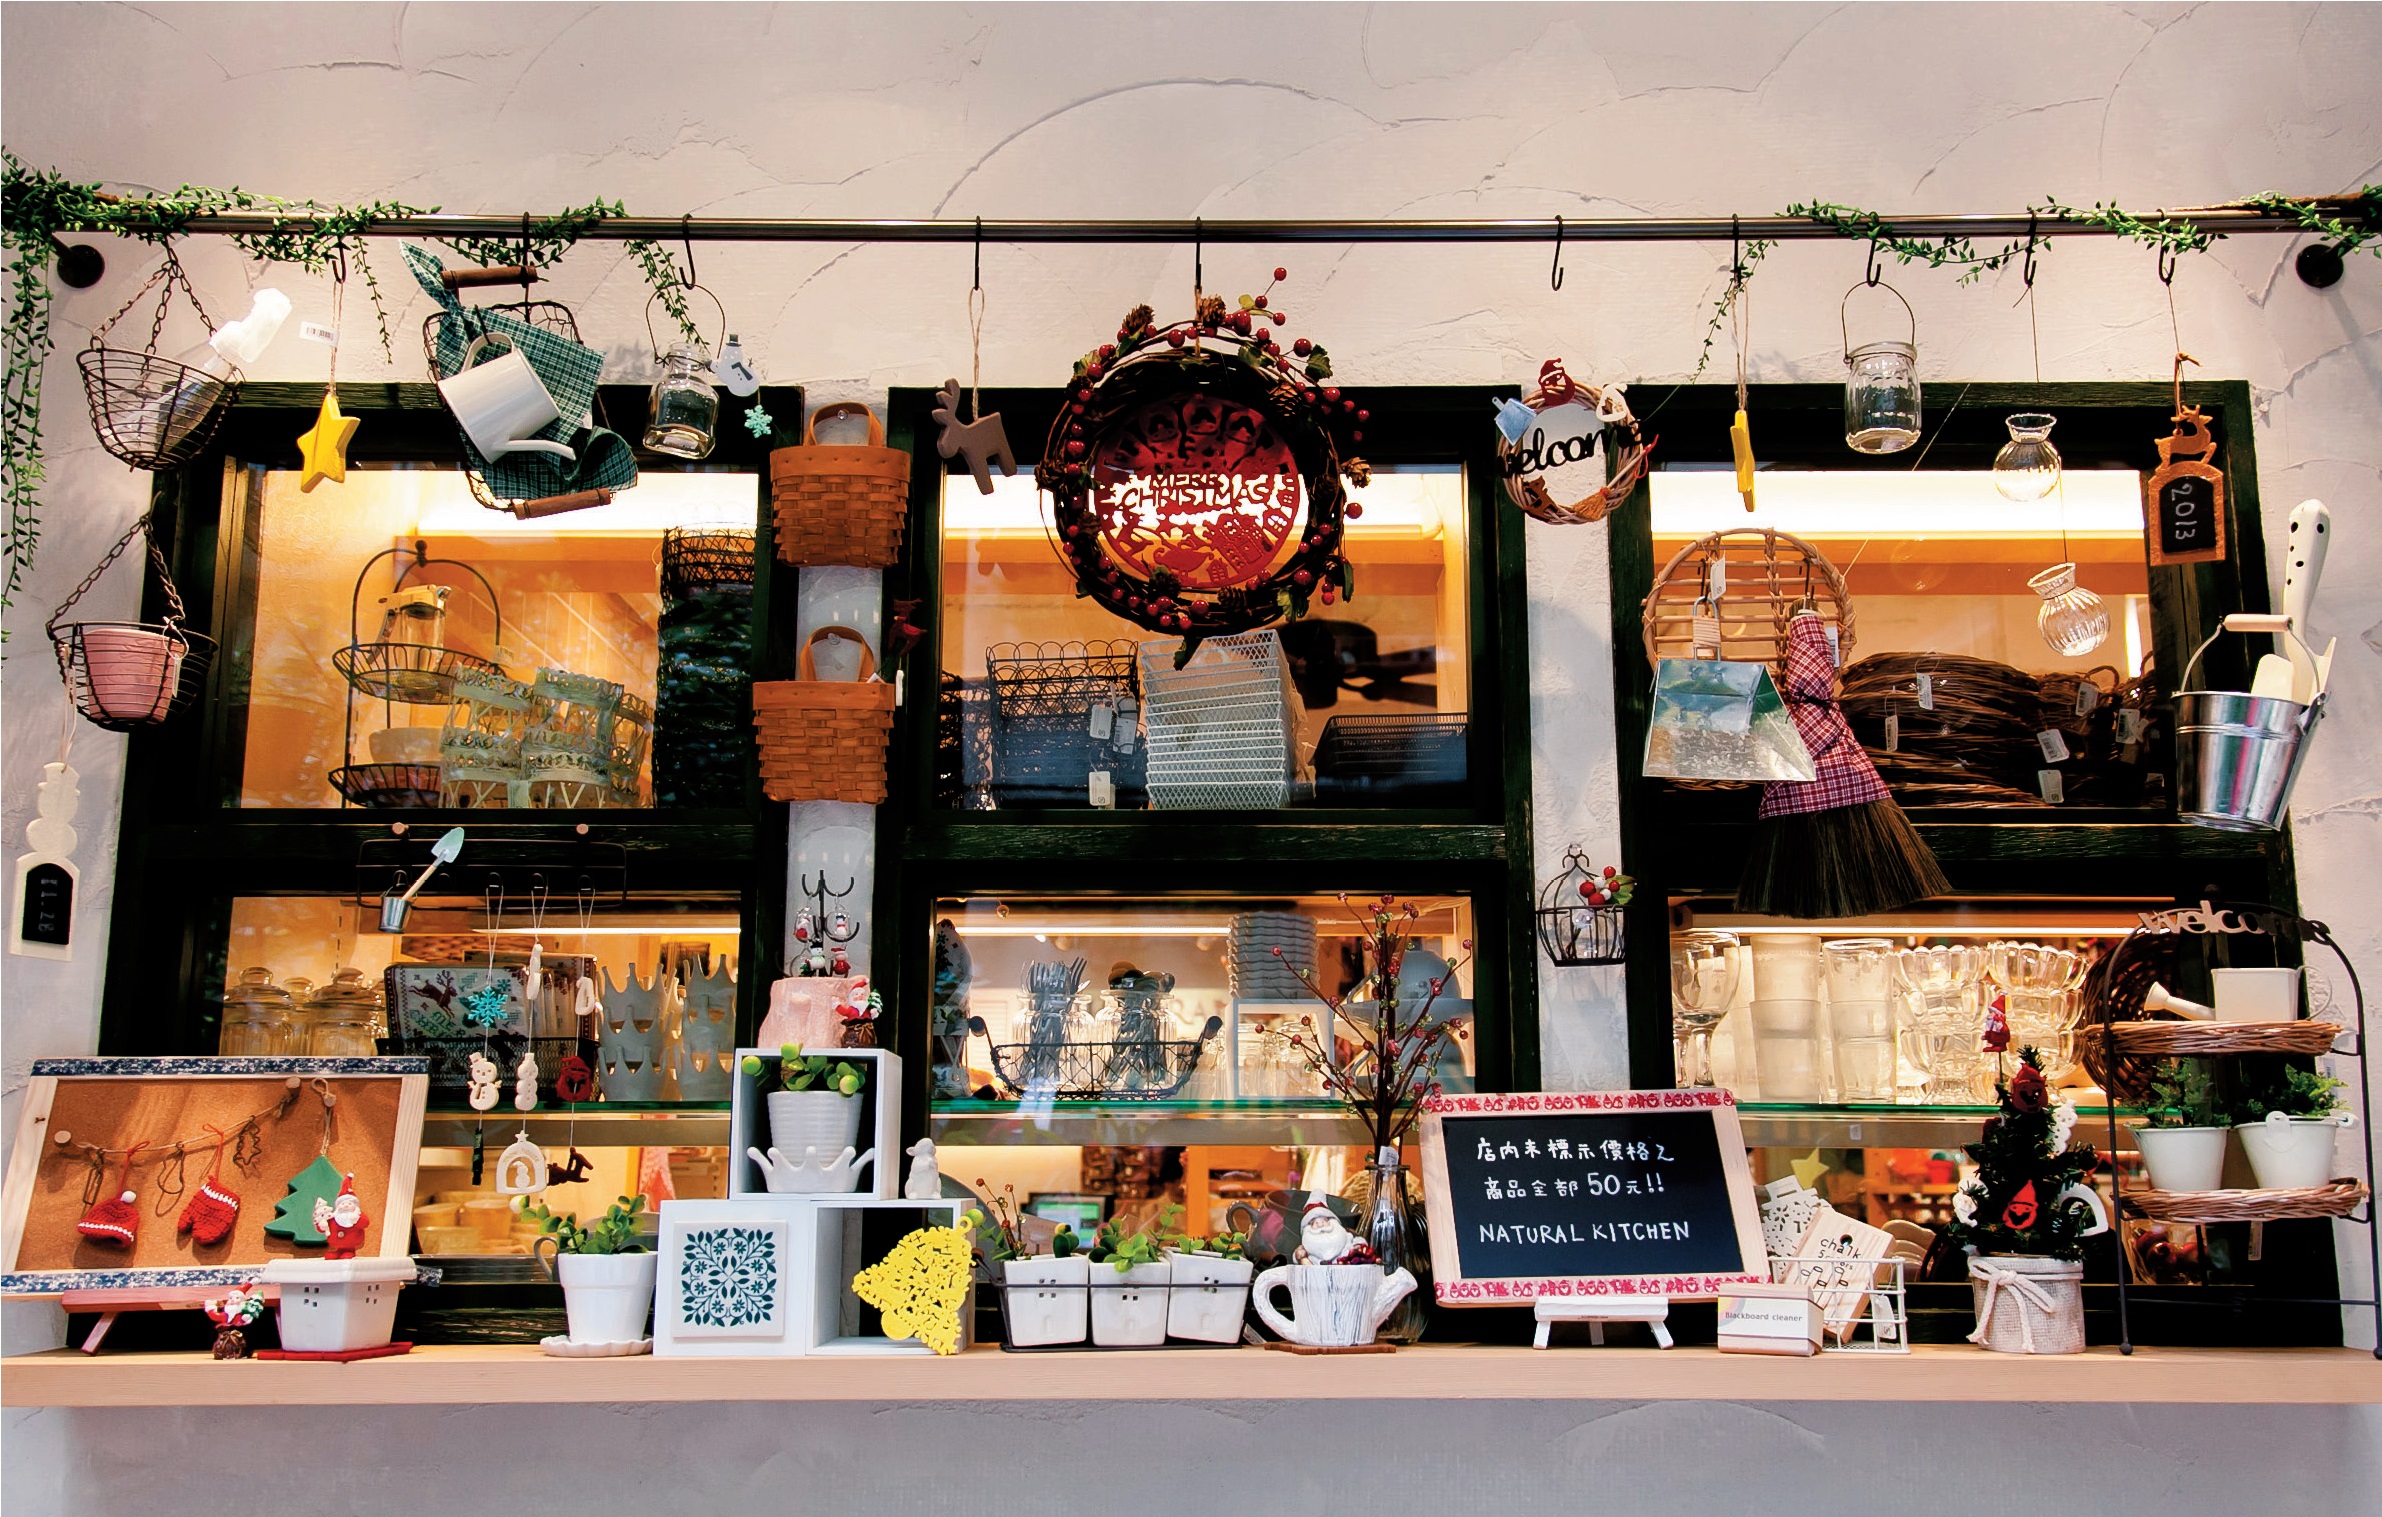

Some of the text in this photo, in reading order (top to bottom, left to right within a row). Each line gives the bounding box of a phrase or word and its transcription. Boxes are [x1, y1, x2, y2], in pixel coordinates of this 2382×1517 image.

[1122, 474, 1270, 508] CHRISTMAS
[2170, 483, 2198, 540] 2013
[1479, 1221, 1690, 1244] NATURAL KITCHEN
[1820, 1238, 1861, 1259] chalk
[1725, 1312, 1803, 1322] Blackboard cleaner
